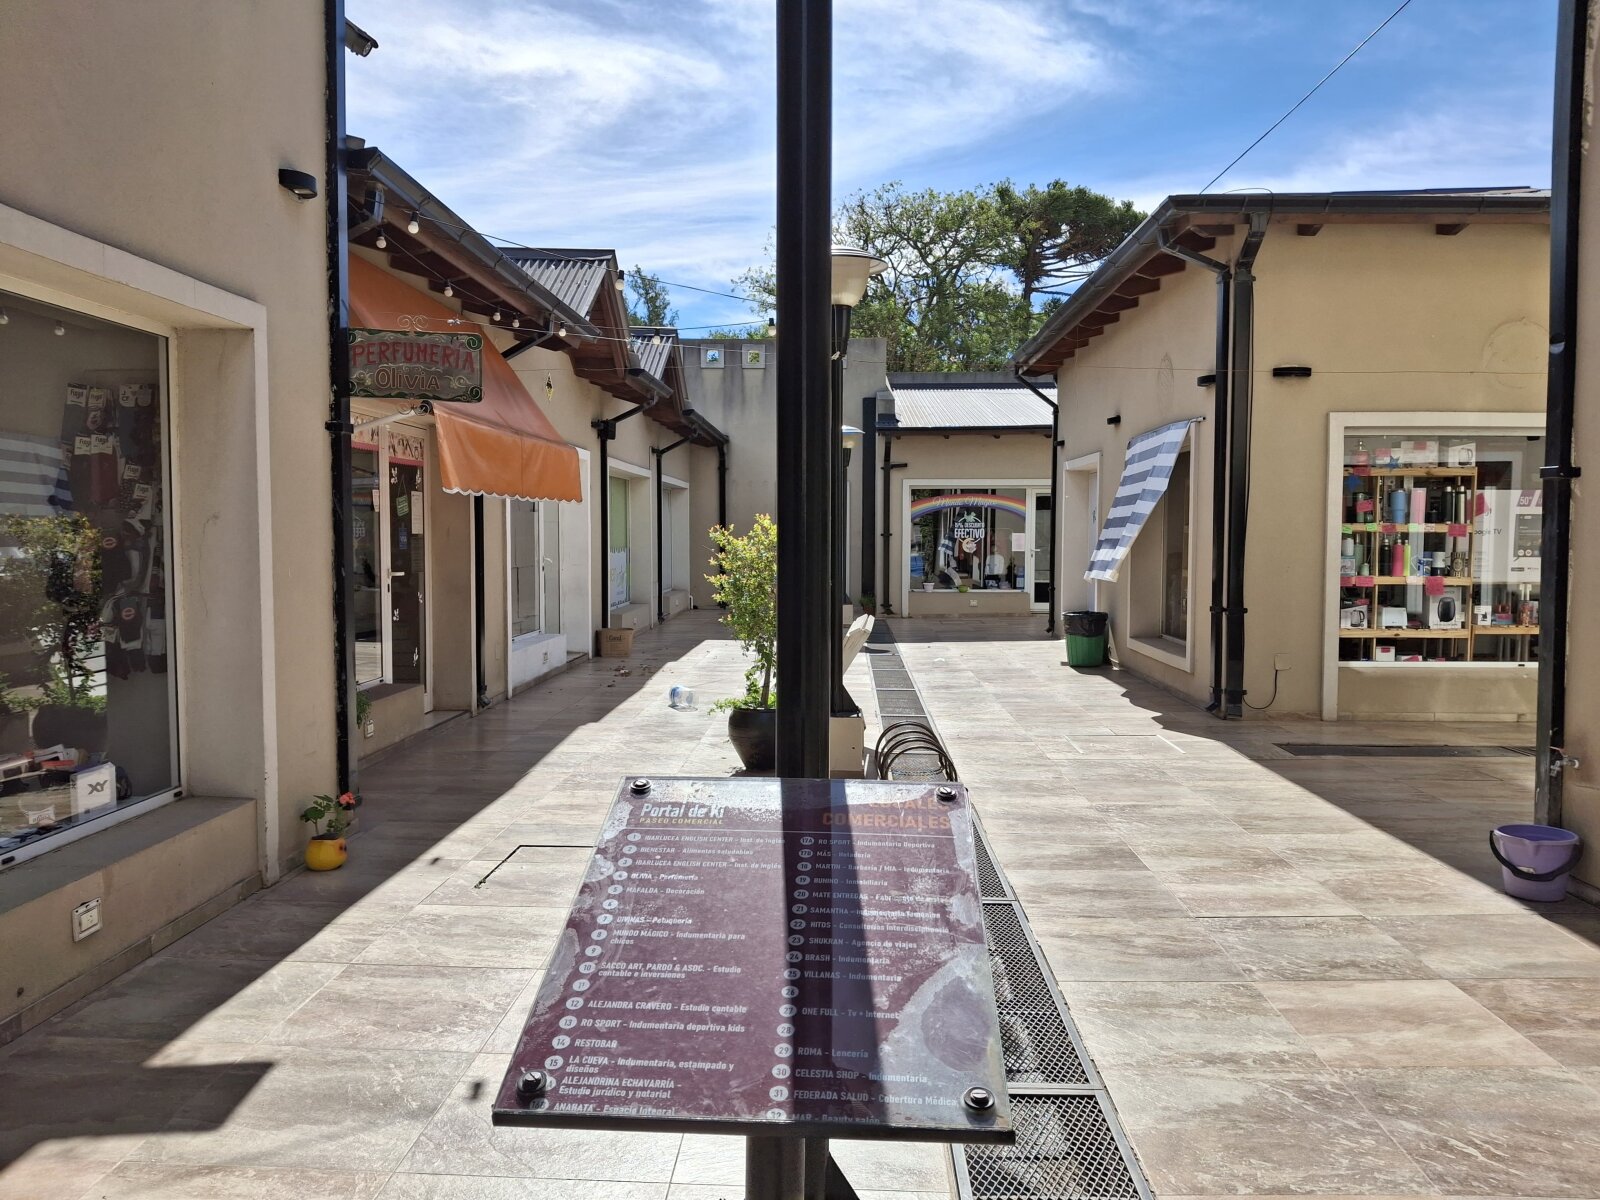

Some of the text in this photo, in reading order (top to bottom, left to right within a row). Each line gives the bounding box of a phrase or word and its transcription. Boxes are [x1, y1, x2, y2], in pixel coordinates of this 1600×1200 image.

[955, 529, 985, 538] EFECTIVO
[641, 803, 683, 818] Portal
[688, 804, 705, 817] de
[822, 812, 950, 829] COMERCIALES
[652, 917, 692, 925] Peluquería
[640, 928, 669, 938] MÁGICO
[676, 931, 726, 939] Indumentaria
[727, 933, 746, 941] para
[851, 939, 882, 948] Agencia
[883, 940, 892, 948] de
[895, 941, 917, 949] viajes
[838, 956, 890, 964] Indumentaria
[600, 962, 626, 970] SACCO
[628, 963, 645, 971] ART,
[713, 965, 741, 973] Estudio
[640, 971, 686, 979] inversiones
[804, 971, 840, 979] VILLANAS
[849, 973, 902, 982] Indumentaria
[588, 1001, 633, 1009] ALEJANDRA
[635, 1002, 672, 1011] CRAVERO
[680, 1003, 710, 1012] Estudio
[712, 1004, 747, 1013] contable
[820, 1008, 839, 1016] FULL
[865, 1010, 900, 1019] Internet
[581, 1019, 592, 1027] RO
[594, 1019, 621, 1028] SPORT
[629, 1021, 685, 1030] Indumentaria
[686, 1022, 726, 1032] deportiva
[728, 1023, 745, 1032] kids
[574, 1039, 618, 1048] RESTOBAR
[798, 1047, 822, 1056] ROMA
[832, 1048, 868, 1058] Lencería
[566, 1065, 599, 1073] diseños
[569, 1056, 580, 1064] LA
[582, 1057, 608, 1065] CUEVA
[617, 1058, 677, 1068] Indumentaria,
[679, 1061, 726, 1071] estampado
[795, 1069, 833, 1078] CELESTIA
[836, 1070, 859, 1079] SHOP
[869, 1072, 928, 1083] Indumentaria
[561, 1076, 620, 1087] ALEJANDRINA
[622, 1077, 675, 1089] ECHAVARRÍA
[559, 1086, 590, 1095] Estudio
[592, 1087, 626, 1098] jurídico
[636, 1089, 671, 1099] notarial
[794, 1091, 838, 1100] FEDERADA
[840, 1092, 868, 1101] SALUD
[878, 1094, 922, 1104] Cobertura
[925, 1095, 957, 1106] Médica
[553, 1103, 594, 1112] ANAHATA
